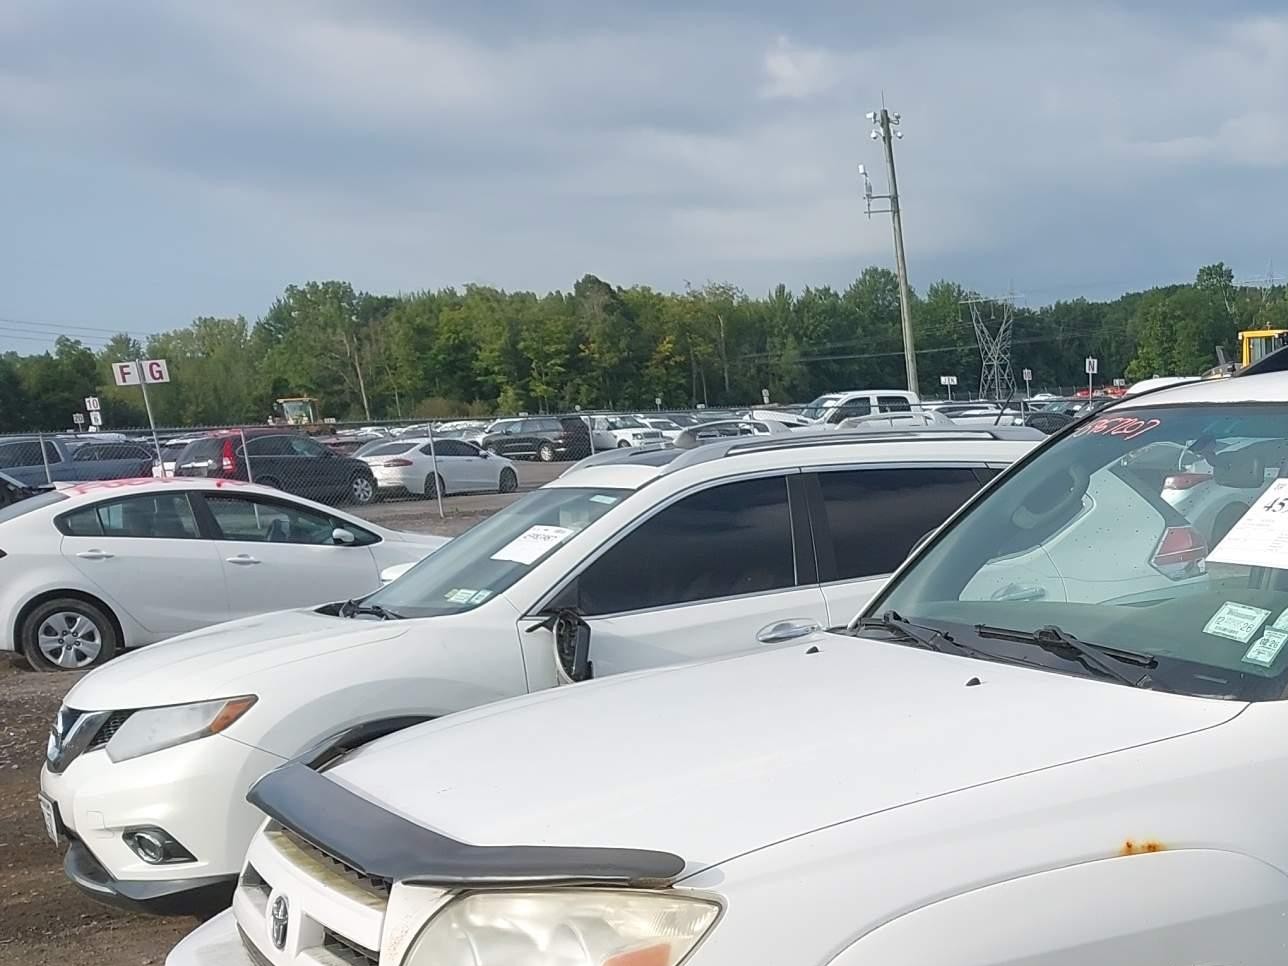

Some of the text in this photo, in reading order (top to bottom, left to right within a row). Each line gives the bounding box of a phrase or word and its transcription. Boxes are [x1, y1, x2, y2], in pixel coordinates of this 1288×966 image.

[1088, 360, 1095, 371] N
[118, 362, 164, 383] F G
[87, 398, 98, 409] 10
